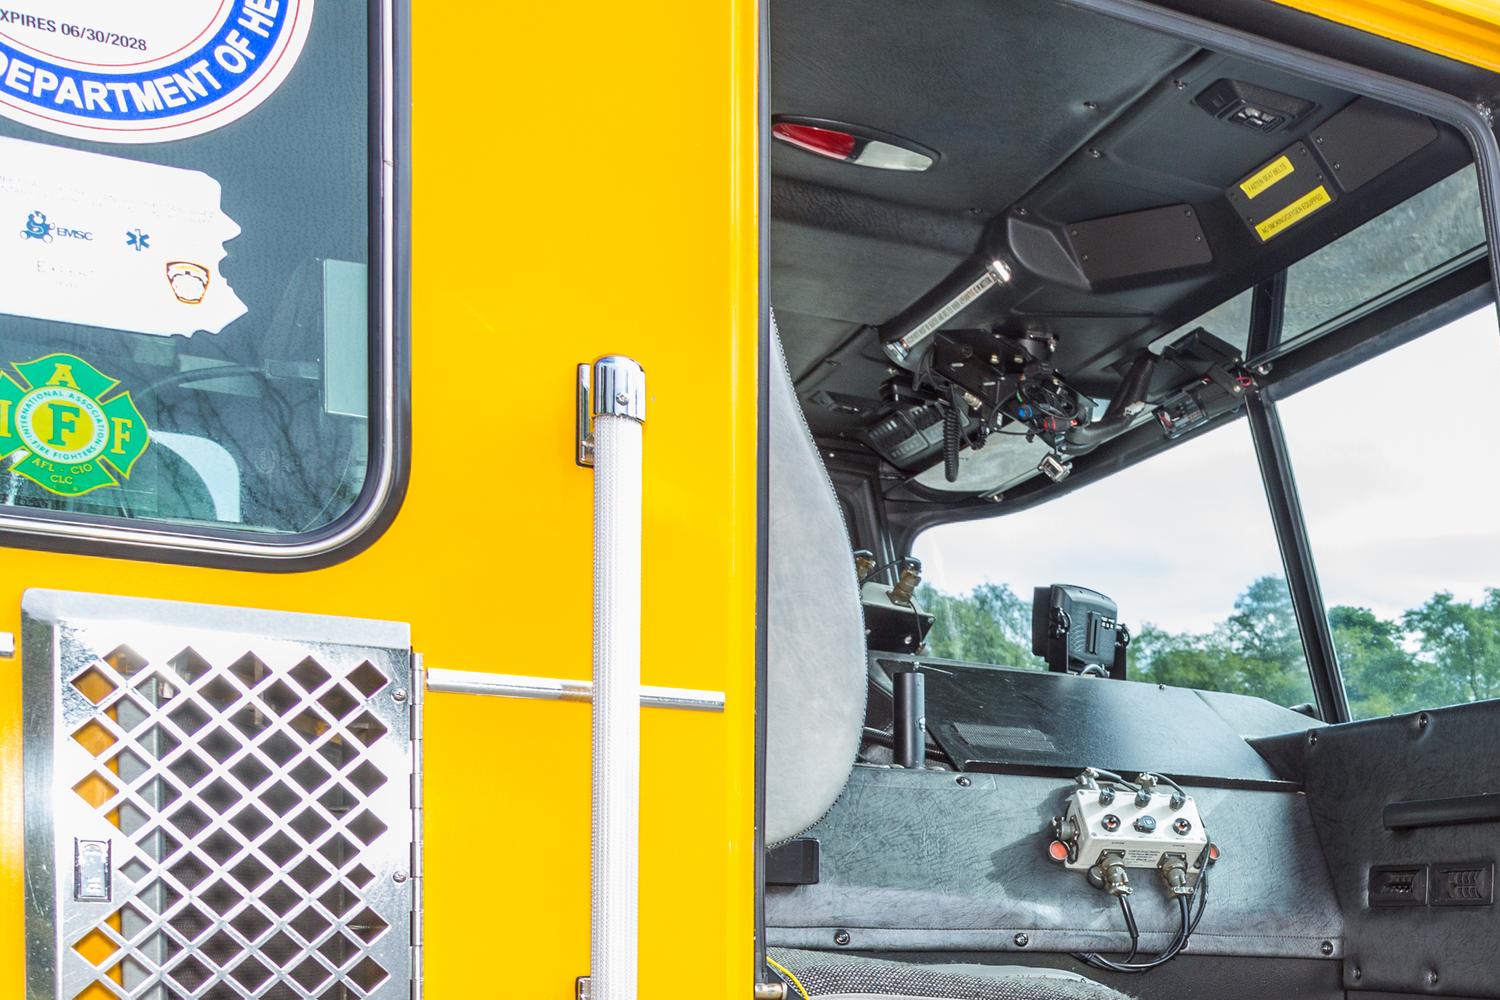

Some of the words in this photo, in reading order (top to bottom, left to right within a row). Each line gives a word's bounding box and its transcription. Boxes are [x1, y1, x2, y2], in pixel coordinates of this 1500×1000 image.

[61, 23, 147, 51] 06/30/2028
[214, 29, 256, 74] OF
[45, 363, 81, 390] A
[47, 403, 80, 446] F
[110, 417, 132, 455] F
[32, 458, 55, 472] AFL
[70, 463, 93, 475] CIO
[49, 474, 73, 485] CLC
